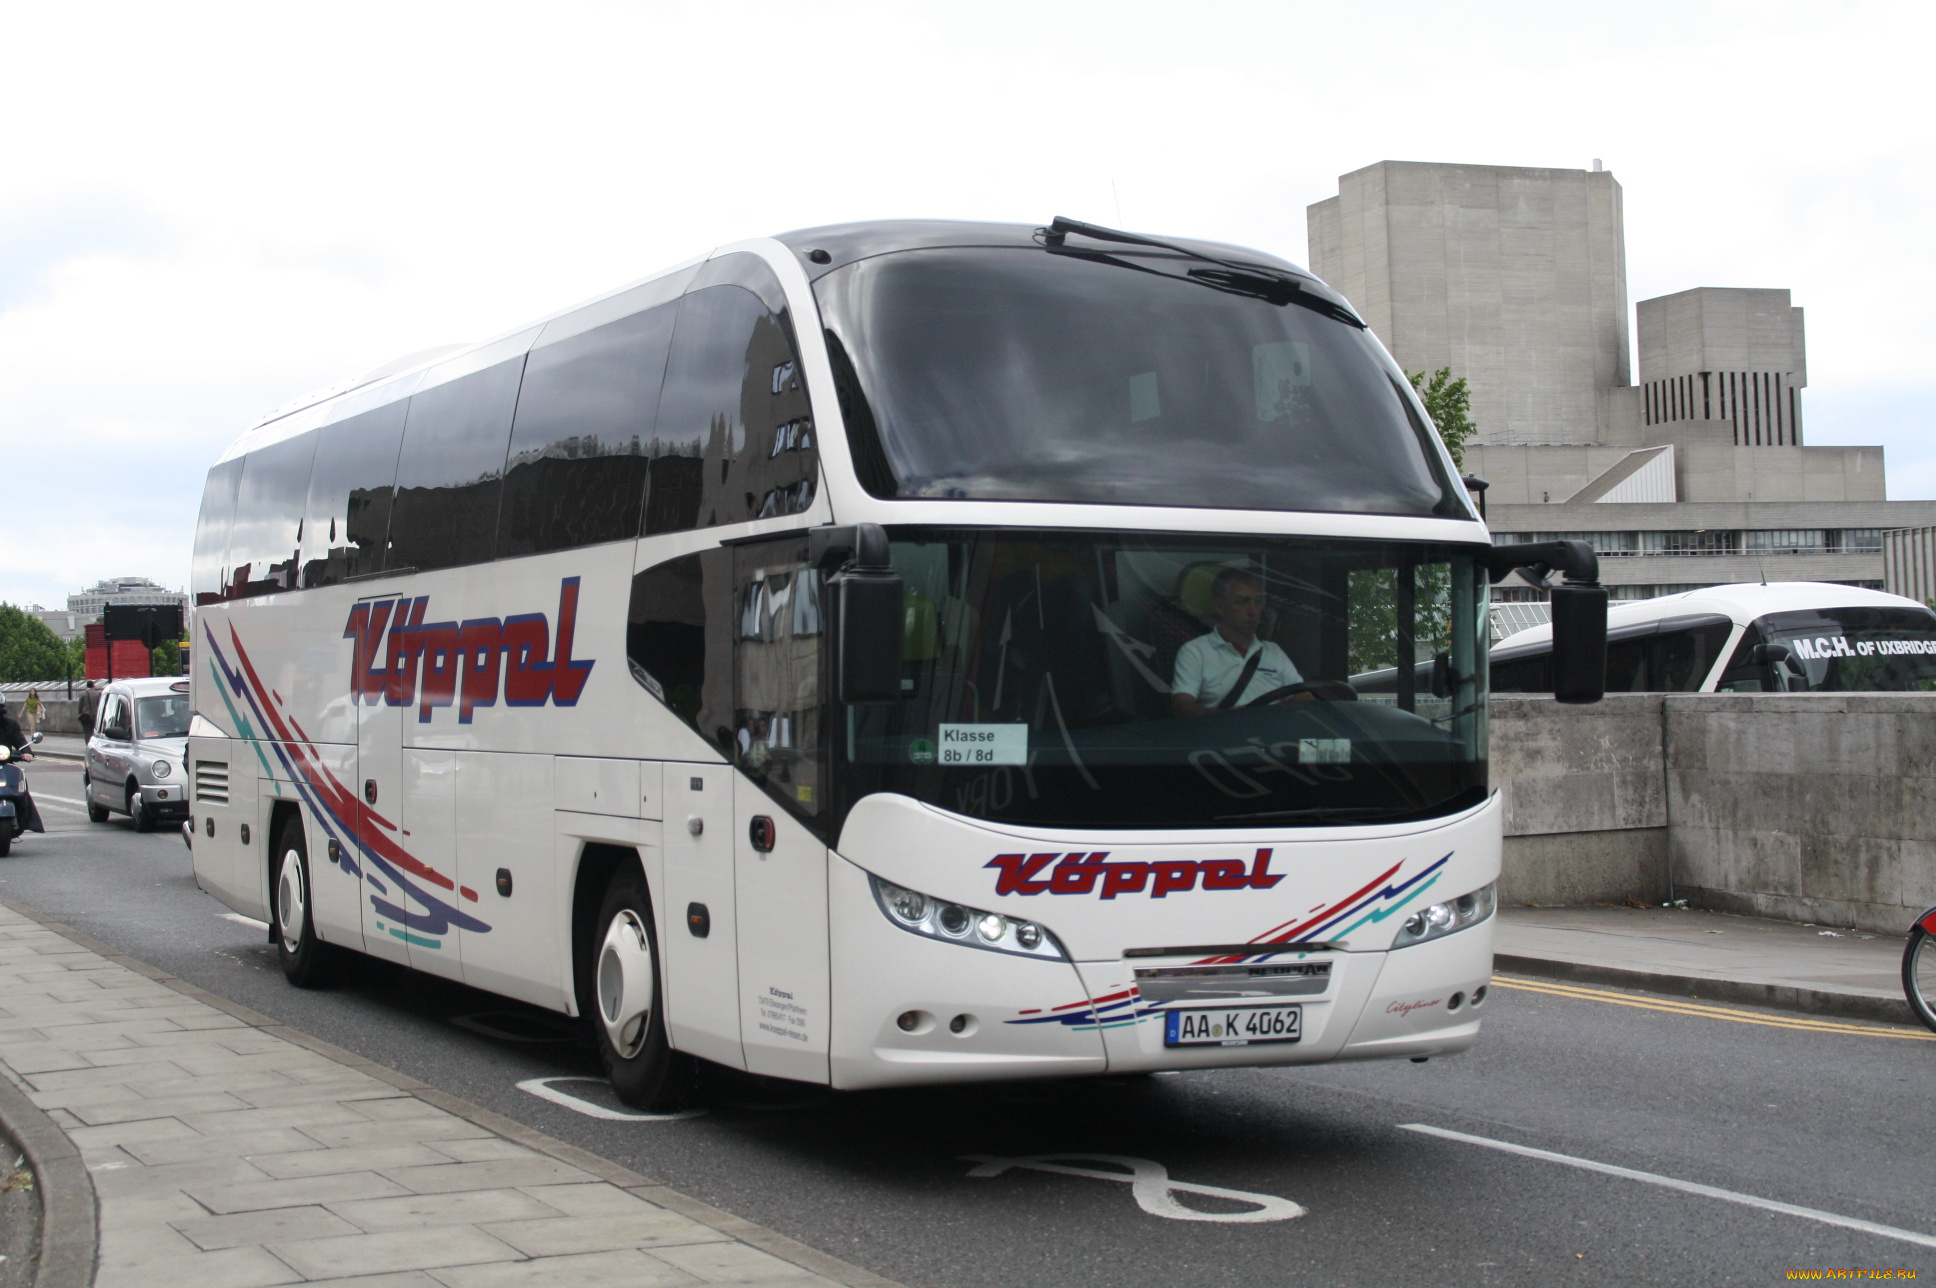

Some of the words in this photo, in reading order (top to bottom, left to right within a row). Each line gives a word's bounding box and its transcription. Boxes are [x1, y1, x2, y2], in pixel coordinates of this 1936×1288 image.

[343, 576, 595, 724] Köppel
[1793, 636, 1856, 660] M.C.H.
[1857, 641, 1875, 656] OF
[944, 729, 995, 742] Klasse
[944, 749, 962, 762] 8b
[975, 749, 994, 762] 8d
[982, 847, 1287, 901] Köppel
[1386, 999, 1443, 1018] Cityliner
[1182, 1014, 1210, 1039] AA
[1226, 1013, 1239, 1037] K
[1246, 1010, 1298, 1036] 4062
